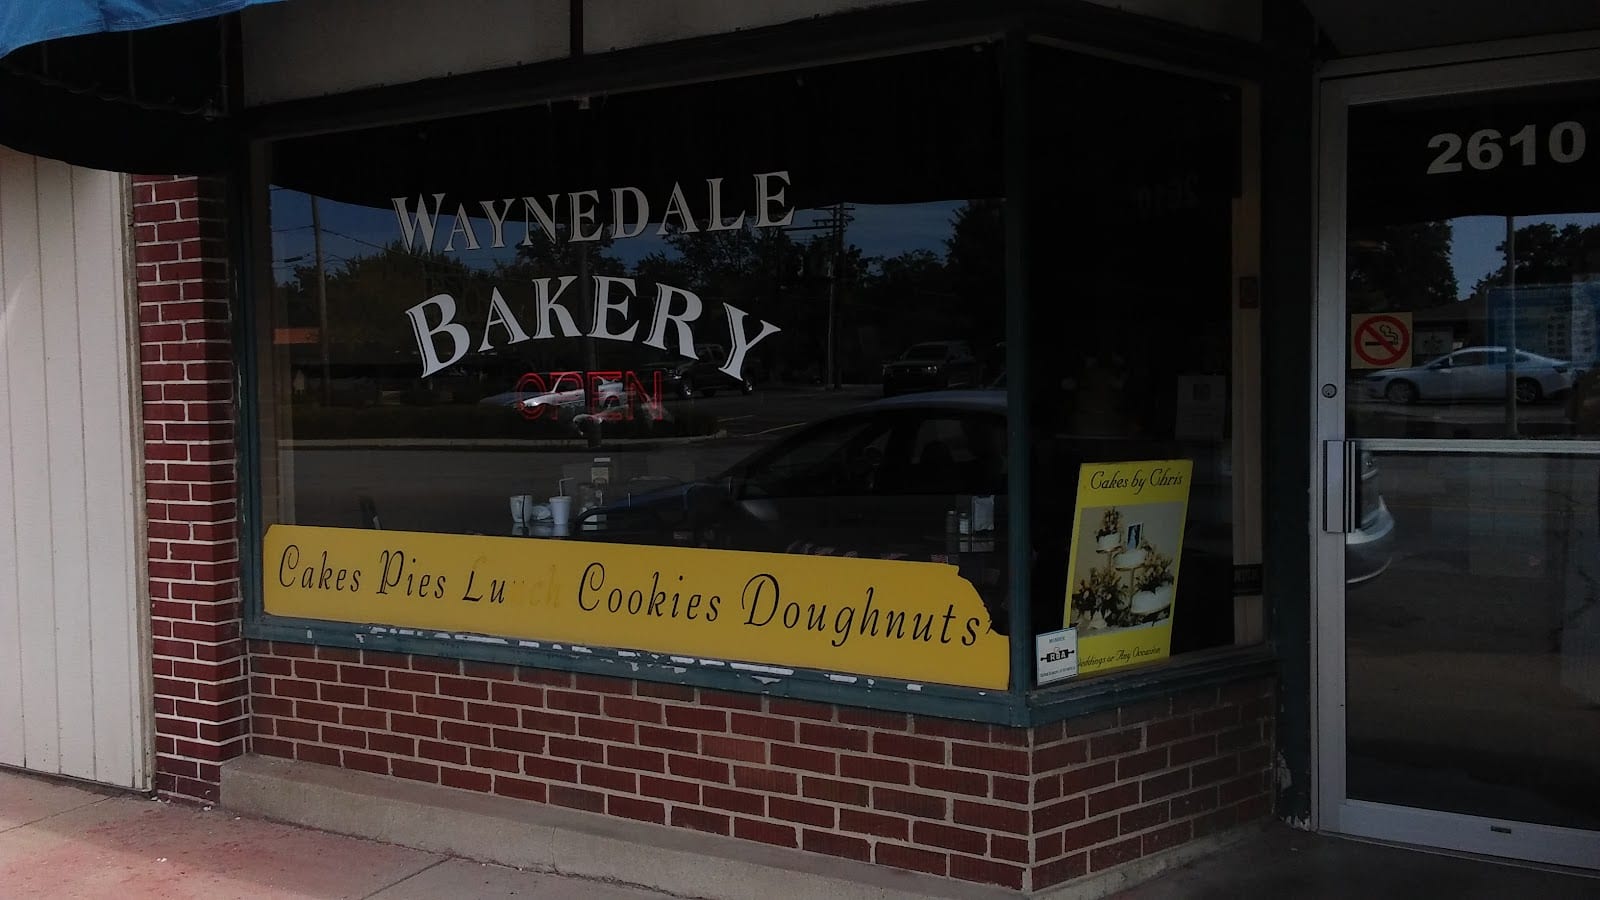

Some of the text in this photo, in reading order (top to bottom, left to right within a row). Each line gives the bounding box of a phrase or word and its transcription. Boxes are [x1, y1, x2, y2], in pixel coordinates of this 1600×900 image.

[1426, 120, 1587, 175] 2610
[391, 170, 795, 256] WAYNEDALE
[405, 274, 782, 381] BAKERY
[516, 370, 663, 421] OPEN
[1090, 467, 1183, 495] Cakes by Chris
[279, 544, 362, 593] Cakes
[376, 549, 447, 600] Pies
[578, 561, 721, 622] Cookies
[741, 573, 981, 648] Doughnuts
